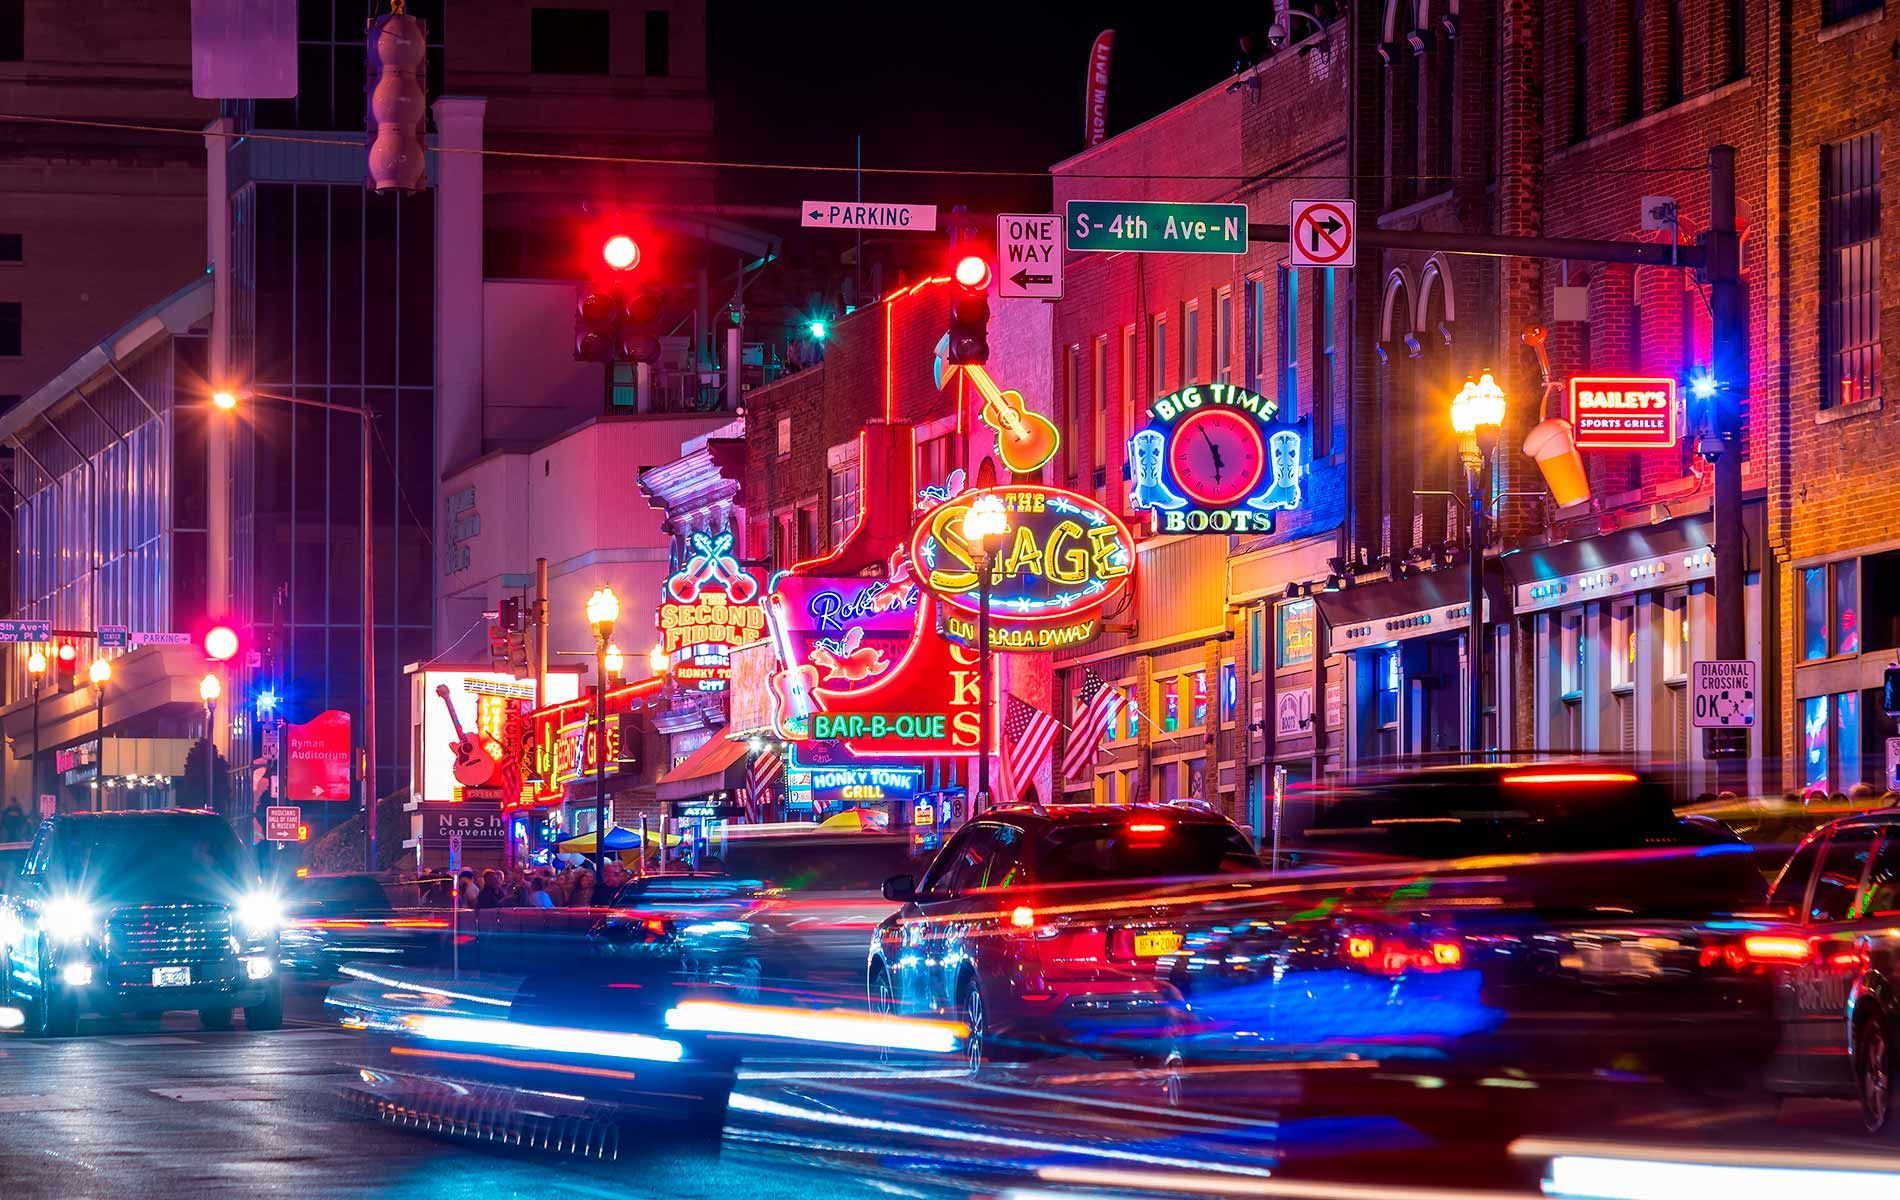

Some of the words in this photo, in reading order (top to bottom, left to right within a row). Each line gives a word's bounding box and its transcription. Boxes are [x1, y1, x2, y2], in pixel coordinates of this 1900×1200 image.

[829, 206, 910, 226] PARKING
[1009, 222, 1052, 240] ONE
[1075, 213, 1148, 239] S-4th
[1163, 215, 1239, 241] Ave-N
[1008, 245, 1053, 262] WAY
[1154, 387, 1202, 421] BIG
[1210, 384, 1278, 422] TIME
[1578, 390, 1667, 409] BAILEY'S
[1580, 419, 1621, 428] SPORTS
[1624, 419, 1665, 428] GRILLE
[1005, 493, 1045, 513] THE
[1165, 510, 1271, 531] BOOTS
[699, 592, 727, 606] THE
[660, 604, 765, 629] SECOND
[949, 618, 975, 640] ON
[143, 634, 181, 643] PARKING
[666, 625, 760, 652] FIDDLE
[678, 668, 715, 679] HONKY
[717, 668, 732, 679] TO
[1701, 664, 1749, 676] DIAGONAL
[698, 680, 726, 691] CITY
[1702, 677, 1749, 689] CROSSING
[1696, 694, 1719, 718] OK
[814, 715, 946, 738] BAR-B-QUE
[291, 739, 325, 748] Ryman
[291, 751, 348, 760] Auditorium
[812, 770, 868, 790] HONKY
[870, 771, 912, 789] TONK
[841, 784, 885, 799] GRILL
[684, 807, 715, 816] ATM
[439, 814, 501, 827] Nash
[439, 828, 505, 837] Conventio
